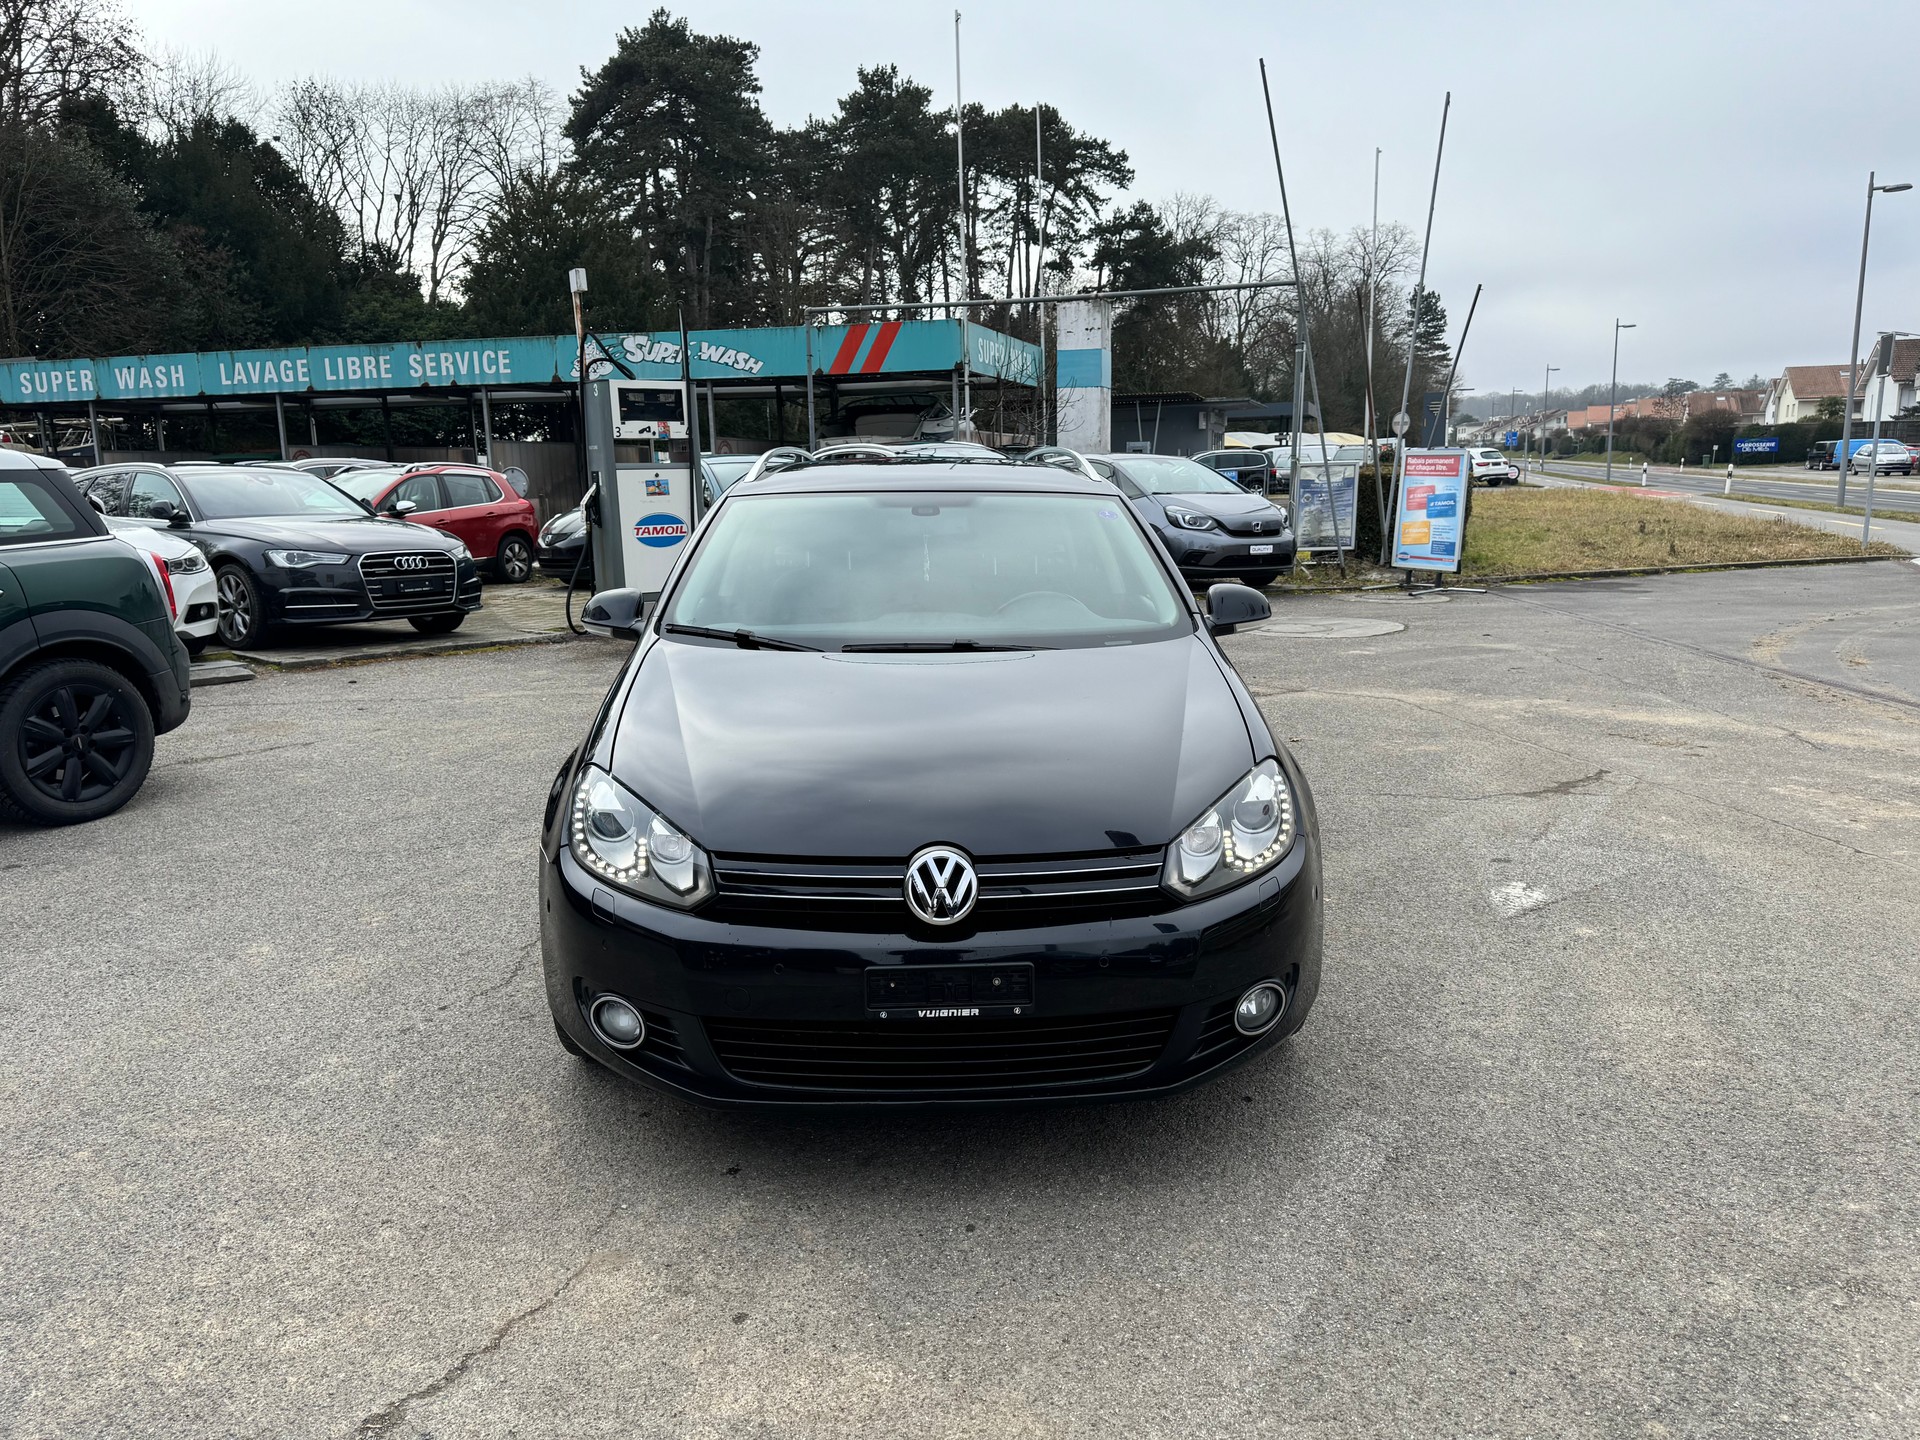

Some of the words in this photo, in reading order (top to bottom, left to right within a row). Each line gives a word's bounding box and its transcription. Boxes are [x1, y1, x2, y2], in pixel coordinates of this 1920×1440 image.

[700, 341, 764, 375] WASH
[19, 369, 94, 394] SUPER
[114, 364, 185, 390] WASH
[219, 358, 310, 386] LAVAGE
[324, 355, 393, 381] LIBRE
[408, 350, 512, 378] SERVICE
[593, 383, 599, 397] 3
[614, 426, 622, 438] 3
[633, 525, 687, 537] TAMOIL
[917, 1008, 980, 1018] VUIGNIER
